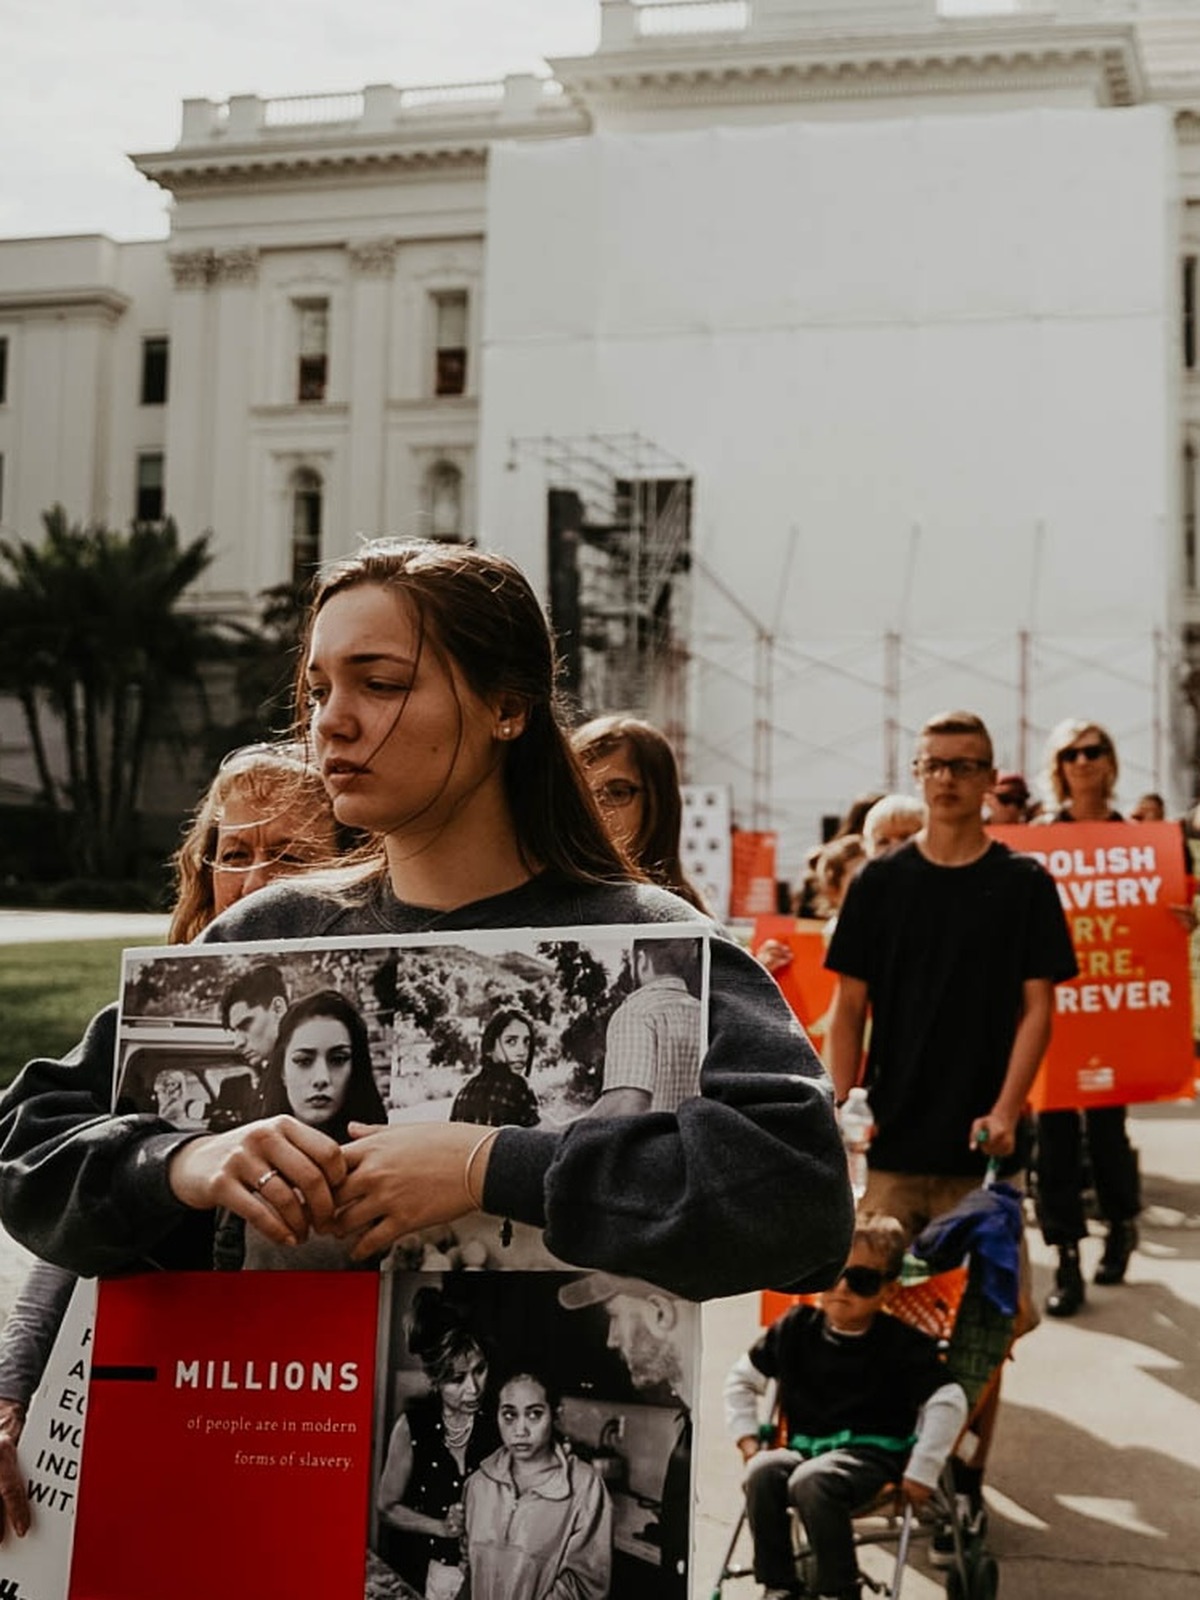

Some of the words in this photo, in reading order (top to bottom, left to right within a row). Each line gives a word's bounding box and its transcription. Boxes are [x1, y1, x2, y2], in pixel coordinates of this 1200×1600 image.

[1074, 914, 1129, 942] RY-
[1055, 979, 1171, 1014] REVER
[175, 1360, 359, 1392] MILLIONS
[187, 1415, 202, 1429] of
[206, 1416, 251, 1434] people
[255, 1420, 279, 1432] are
[283, 1417, 297, 1432] in
[301, 1417, 357, 1433] modern
[36, 1449, 78, 1480] IND
[235, 1450, 275, 1466] forms
[279, 1452, 296, 1466] of
